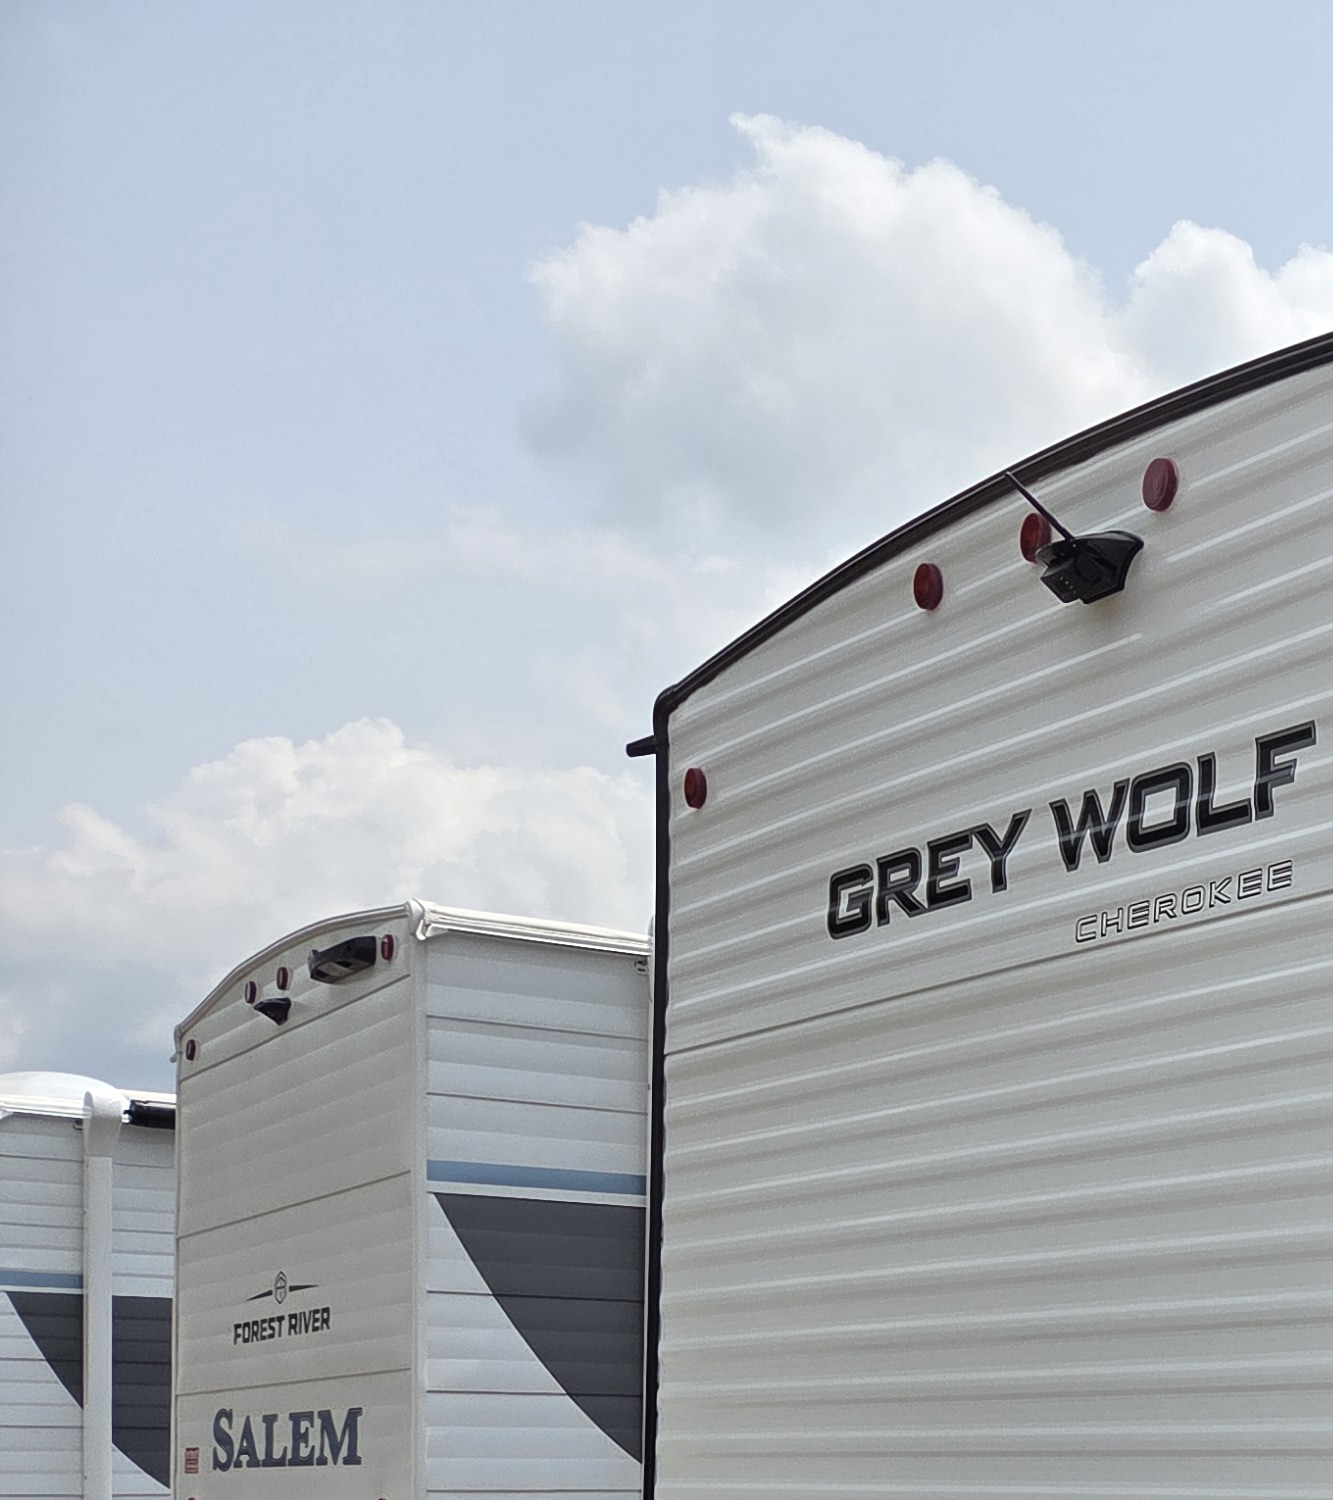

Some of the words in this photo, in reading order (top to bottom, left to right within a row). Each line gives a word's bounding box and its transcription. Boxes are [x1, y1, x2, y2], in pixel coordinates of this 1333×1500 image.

[828, 807, 1033, 940] GREY
[1049, 719, 1317, 873] WOLF
[1074, 859, 1294, 944] CHEROKEE
[233, 1314, 286, 1345] FOREST
[287, 1306, 331, 1336] RIVER
[212, 1407, 364, 1473] SALEM
